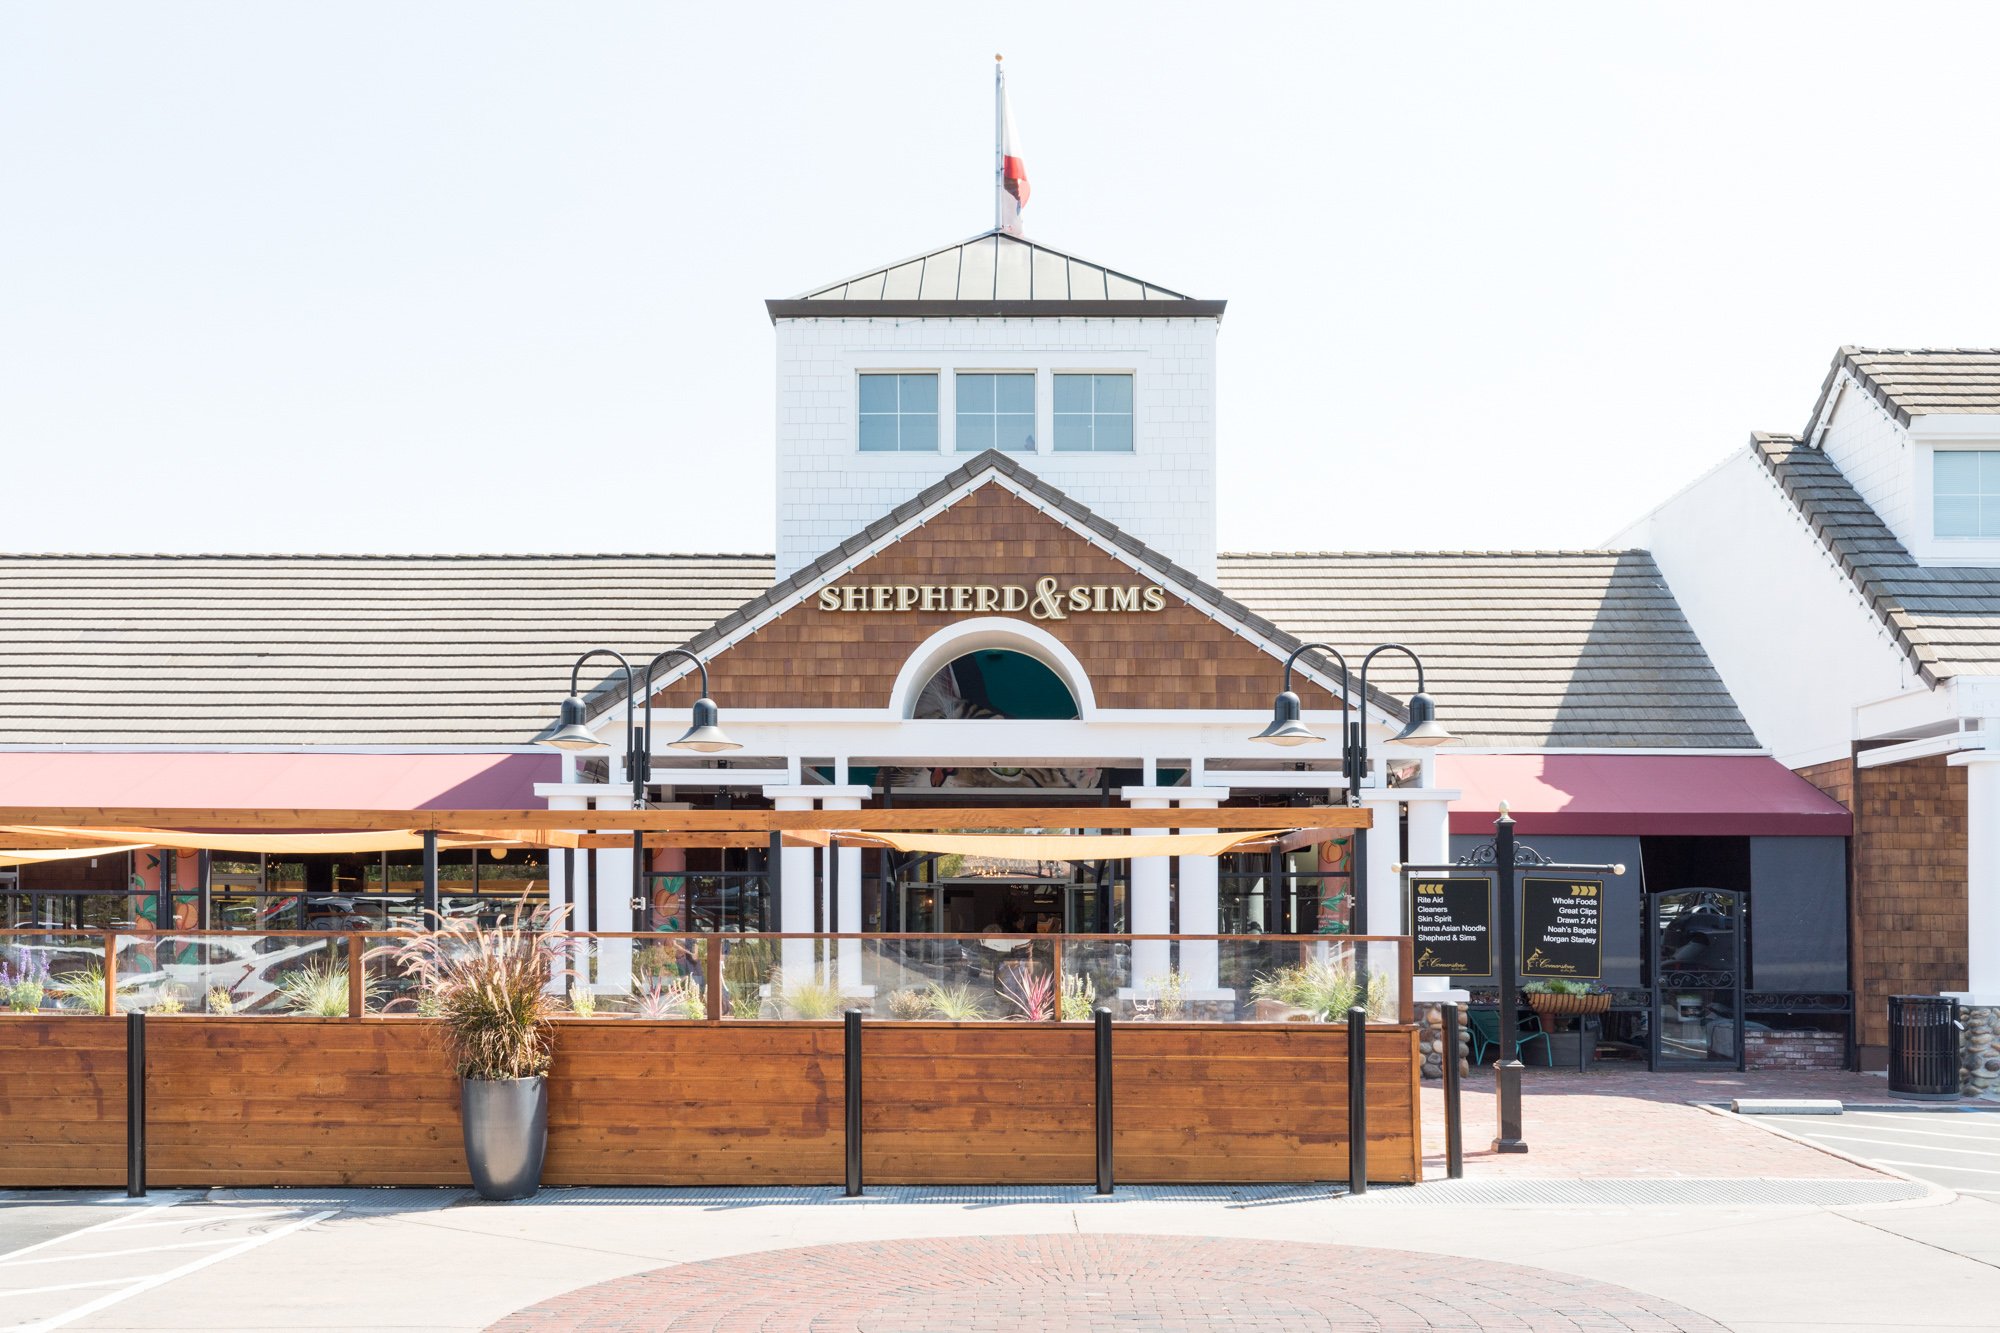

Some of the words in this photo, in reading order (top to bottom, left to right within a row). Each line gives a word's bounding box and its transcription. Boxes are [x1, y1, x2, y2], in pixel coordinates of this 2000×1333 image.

[1552, 897, 1574, 905] Whole
[1579, 908, 1597, 916] Clips
[1434, 915, 1452, 923] Spirit
[1557, 916, 1579, 924] Drawn
[1573, 927, 1597, 935] Bagels
[1418, 934, 1451, 942] Shepherd
[1543, 935, 1569, 943] Morgan
[1570, 936, 1597, 945] Stanley
